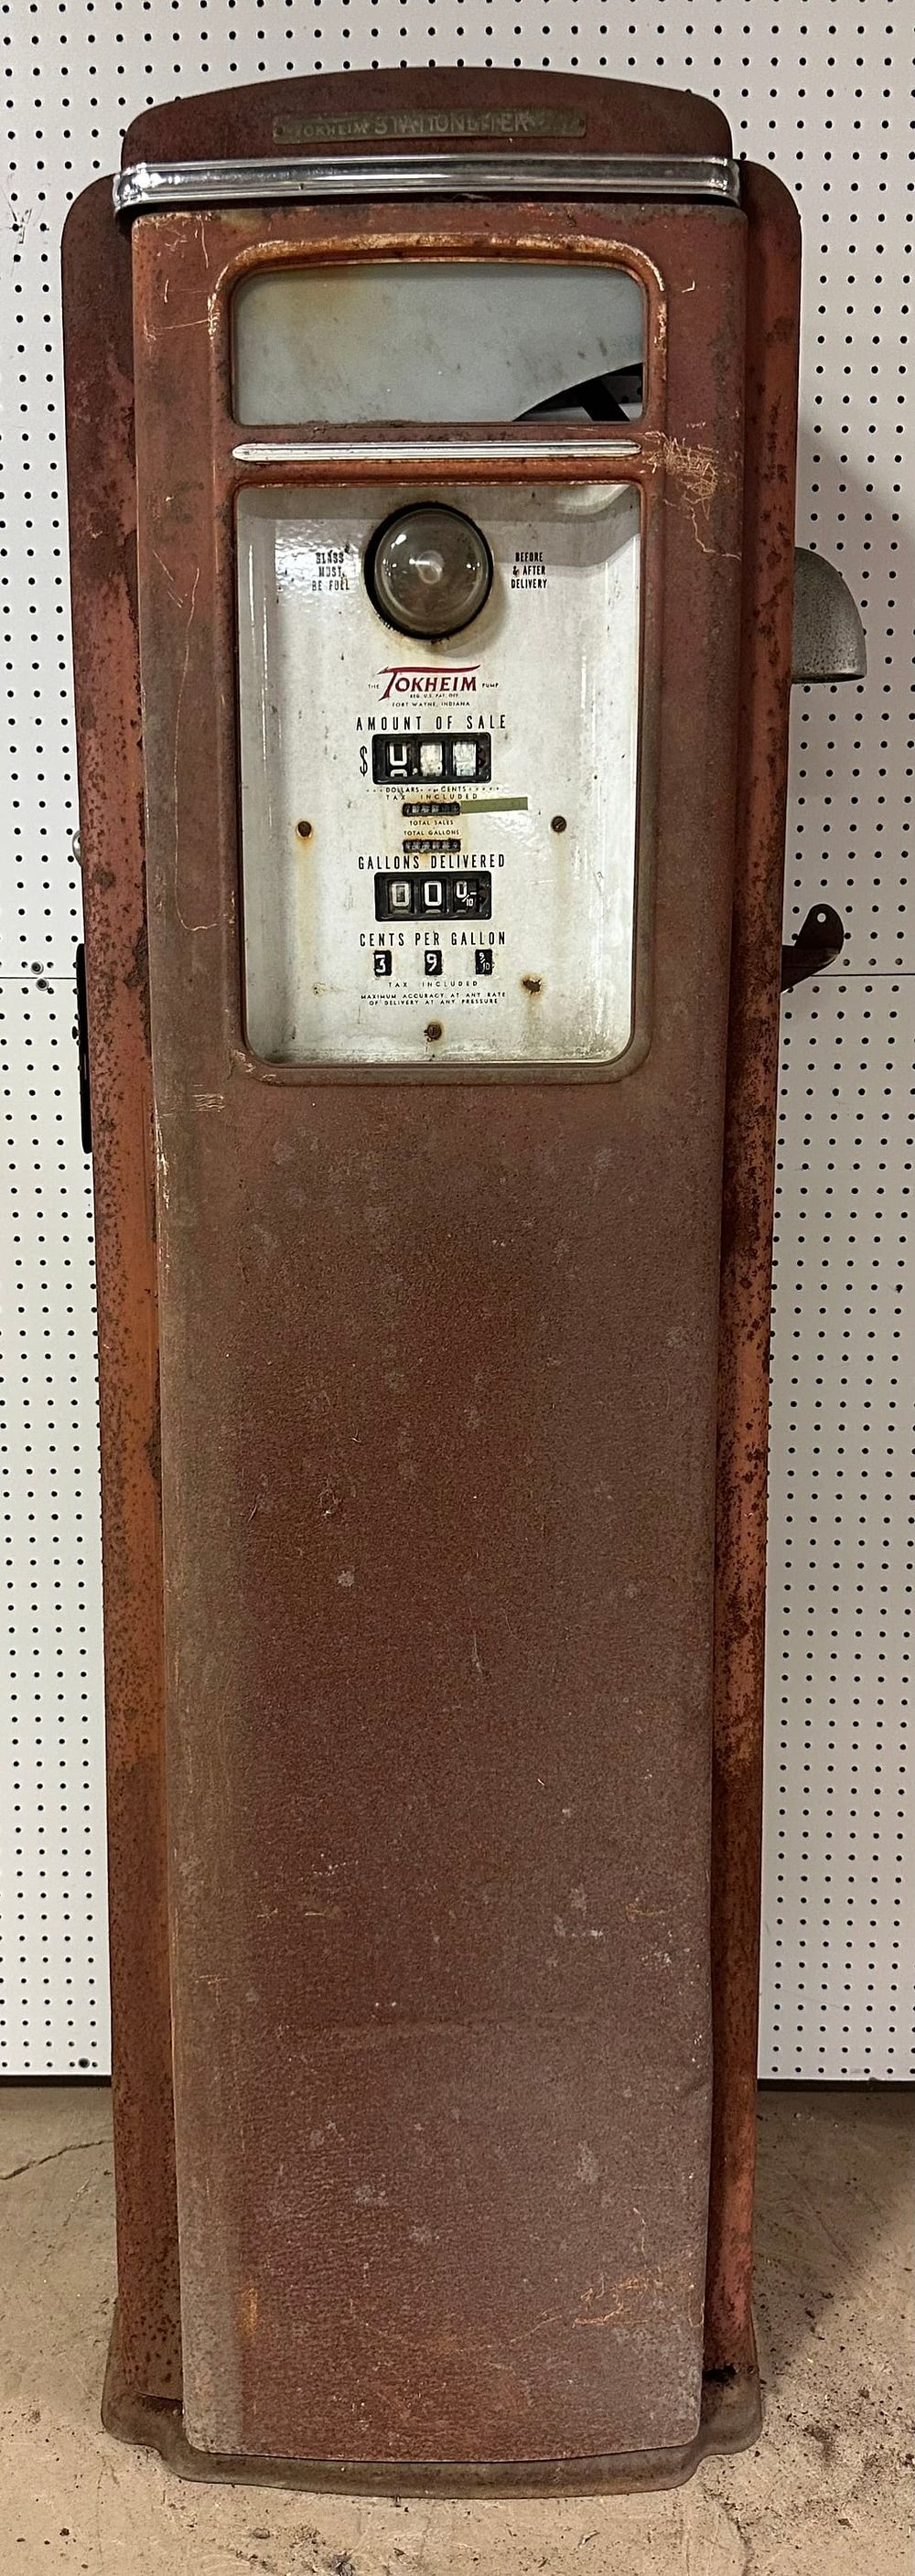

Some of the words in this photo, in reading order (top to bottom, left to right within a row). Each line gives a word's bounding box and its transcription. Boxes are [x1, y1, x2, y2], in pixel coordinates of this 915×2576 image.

[515, 552, 544, 563] BEFORE
[512, 565, 520, 577] &
[522, 565, 546, 576] AFTER
[311, 579, 322, 591] BE
[328, 577, 350, 591] FULL
[511, 578, 548, 590] DELIVERY
[376, 664, 481, 702] TOKHEIM
[356, 716, 421, 731] AMOUNT
[436, 716, 453, 730] OF
[467, 714, 506, 729] SALE
[360, 746, 368, 776] $
[358, 855, 419, 870] GALLONS
[431, 853, 504, 868] DELIVERED
[360, 933, 404, 947] CENTS
[414, 932, 440, 946] PER
[451, 931, 505, 946] GALLON
[375, 953, 386, 973] 3
[426, 953, 437, 972] 9
